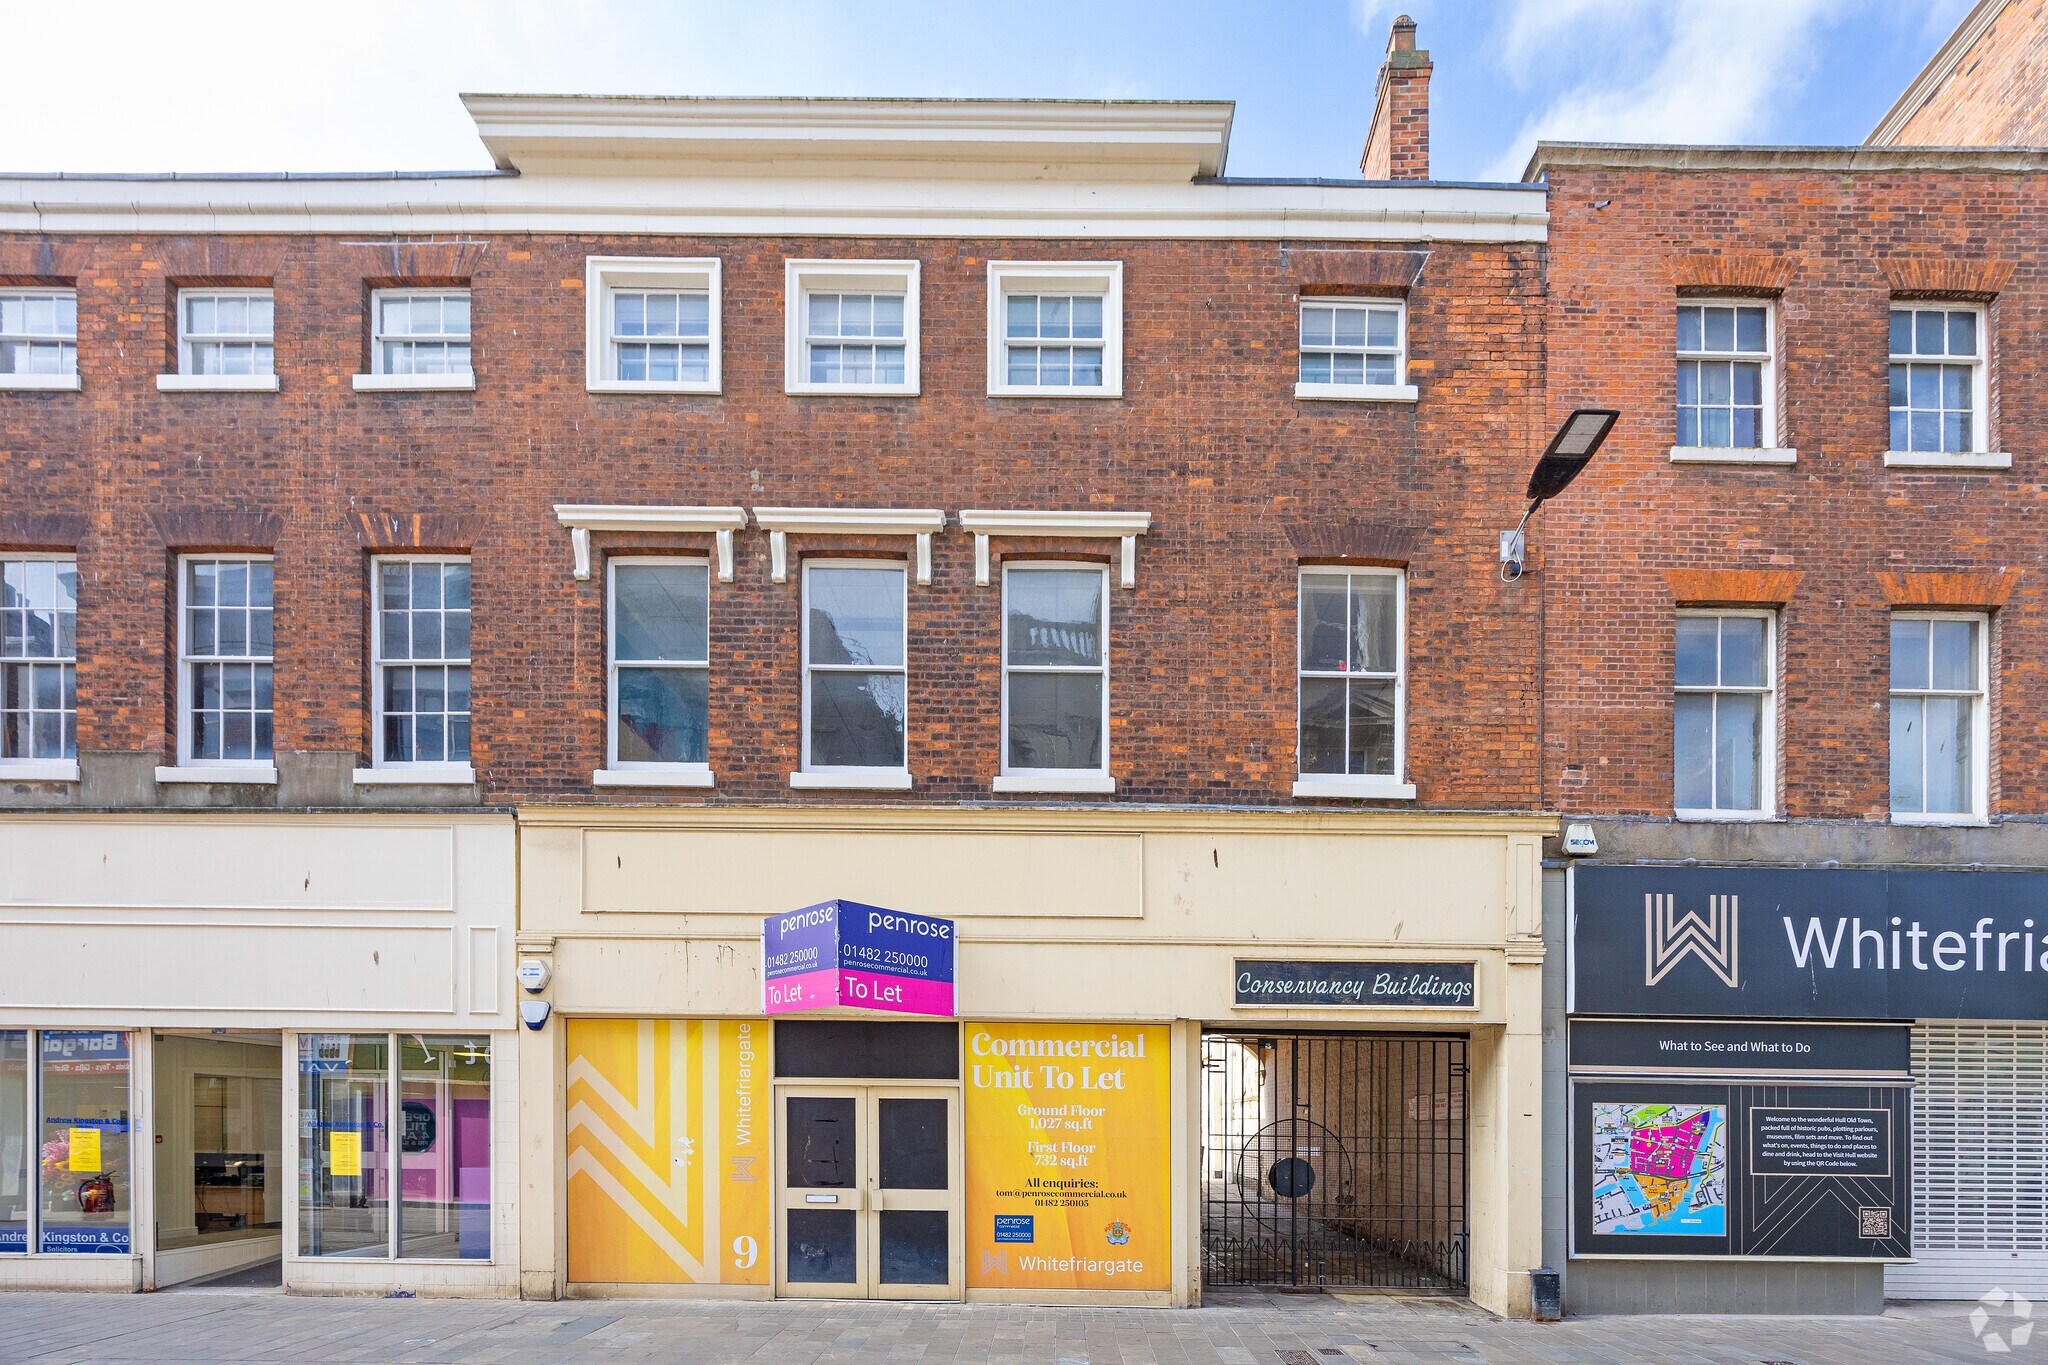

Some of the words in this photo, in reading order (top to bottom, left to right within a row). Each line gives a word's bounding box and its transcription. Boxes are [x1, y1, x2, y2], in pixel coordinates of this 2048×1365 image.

[781, 906, 833, 940] penrose
[869, 912, 949, 939] penrose
[1783, 916, 2048, 971] Whitefri
[768, 952, 788, 968] 01482
[790, 947, 818, 964] 250000
[844, 944, 880, 961] 01482
[885, 951, 928, 968] 250000
[768, 961, 818, 977] penrosecommercial.co.uk
[844, 960, 928, 976] penrosecommercial.co.uk
[768, 986, 781, 1004] To
[784, 983, 802, 1003] Let
[845, 977, 867, 998] To
[874, 981, 902, 1002] Let
[1236, 972, 1365, 999] Conservancy
[1372, 973, 1472, 1002] Buildings
[972, 1032, 1145, 1058] Commercial
[1660, 1040, 1688, 1050] What
[1691, 1041, 1701, 1051] to
[1704, 1041, 1724, 1051] See
[1727, 1042, 1747, 1052] and
[1750, 1042, 1779, 1052] What
[1781, 1043, 1793, 1052] to
[1796, 1043, 1810, 1053] Do
[737, 1023, 754, 1146] Whitefriargate
[972, 1065, 1033, 1088] Unit
[1040, 1065, 1074, 1089] To
[1081, 1066, 1126, 1089] Let
[1018, 1104, 1067, 1116] Ground
[1071, 1105, 1105, 1116] Floor
[1030, 1118, 1062, 1130] 1,027
[1065, 1118, 1093, 1132] sq.ft
[1028, 1142, 1057, 1152] First
[1061, 1142, 1096, 1153] Floor
[1035, 1155, 1057, 1166] 732
[1060, 1154, 1088, 1168] sq.ft
[996, 1190, 1127, 1198] tom@penrosecommercial.co.uk
[1025, 1178, 1040, 1187] All
[1043, 1179, 1098, 1190] enquiries:
[997, 1218, 1030, 1226] penrose
[0, 1232, 27, 1242] ndre
[43, 1232, 96, 1244] Kingston
[100, 1232, 109, 1242] &
[733, 1235, 757, 1269] 9
[1019, 1256, 1143, 1276] Whitefriargate
